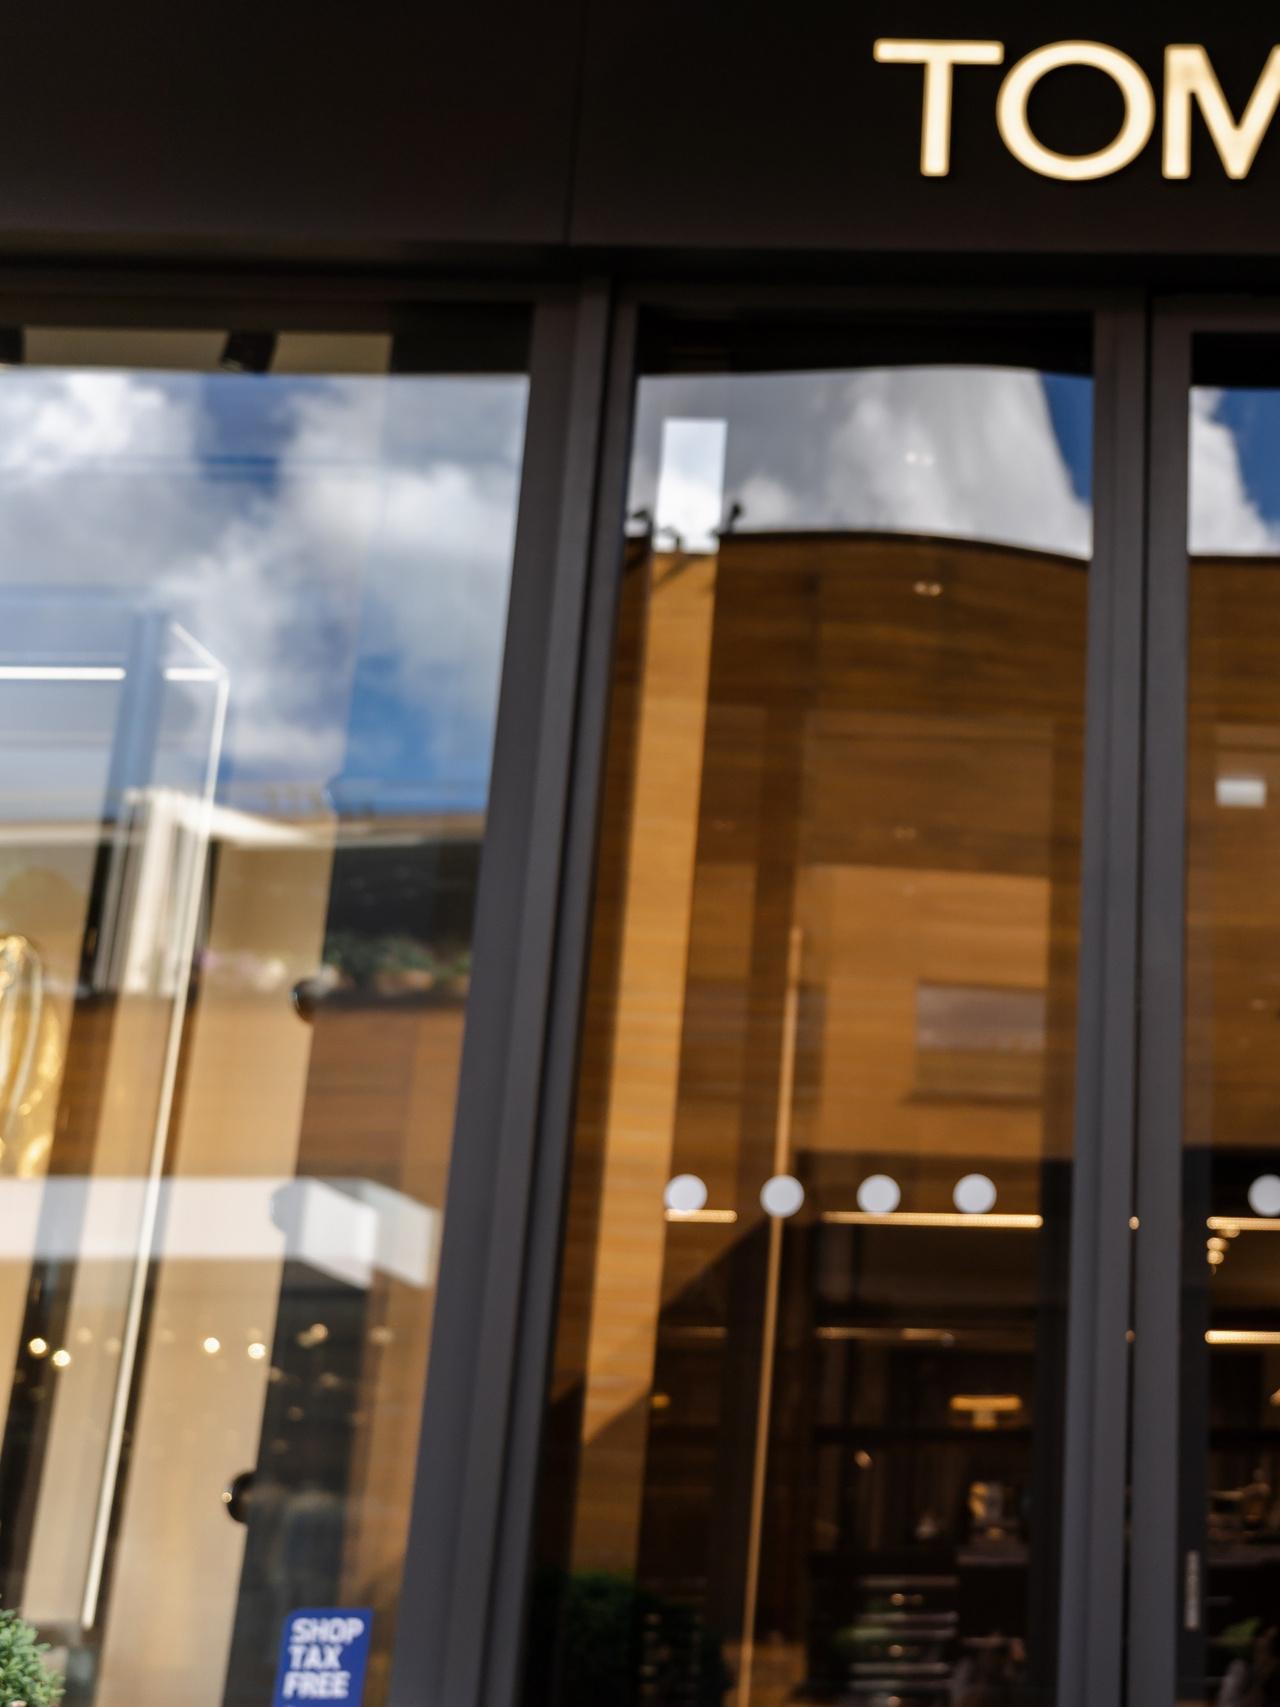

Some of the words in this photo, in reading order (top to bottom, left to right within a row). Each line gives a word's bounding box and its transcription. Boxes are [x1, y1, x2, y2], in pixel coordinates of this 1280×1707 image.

[290, 1617, 364, 1644] SHOP
[288, 1644, 342, 1670] TAX
[282, 1671, 350, 1699] FREE
